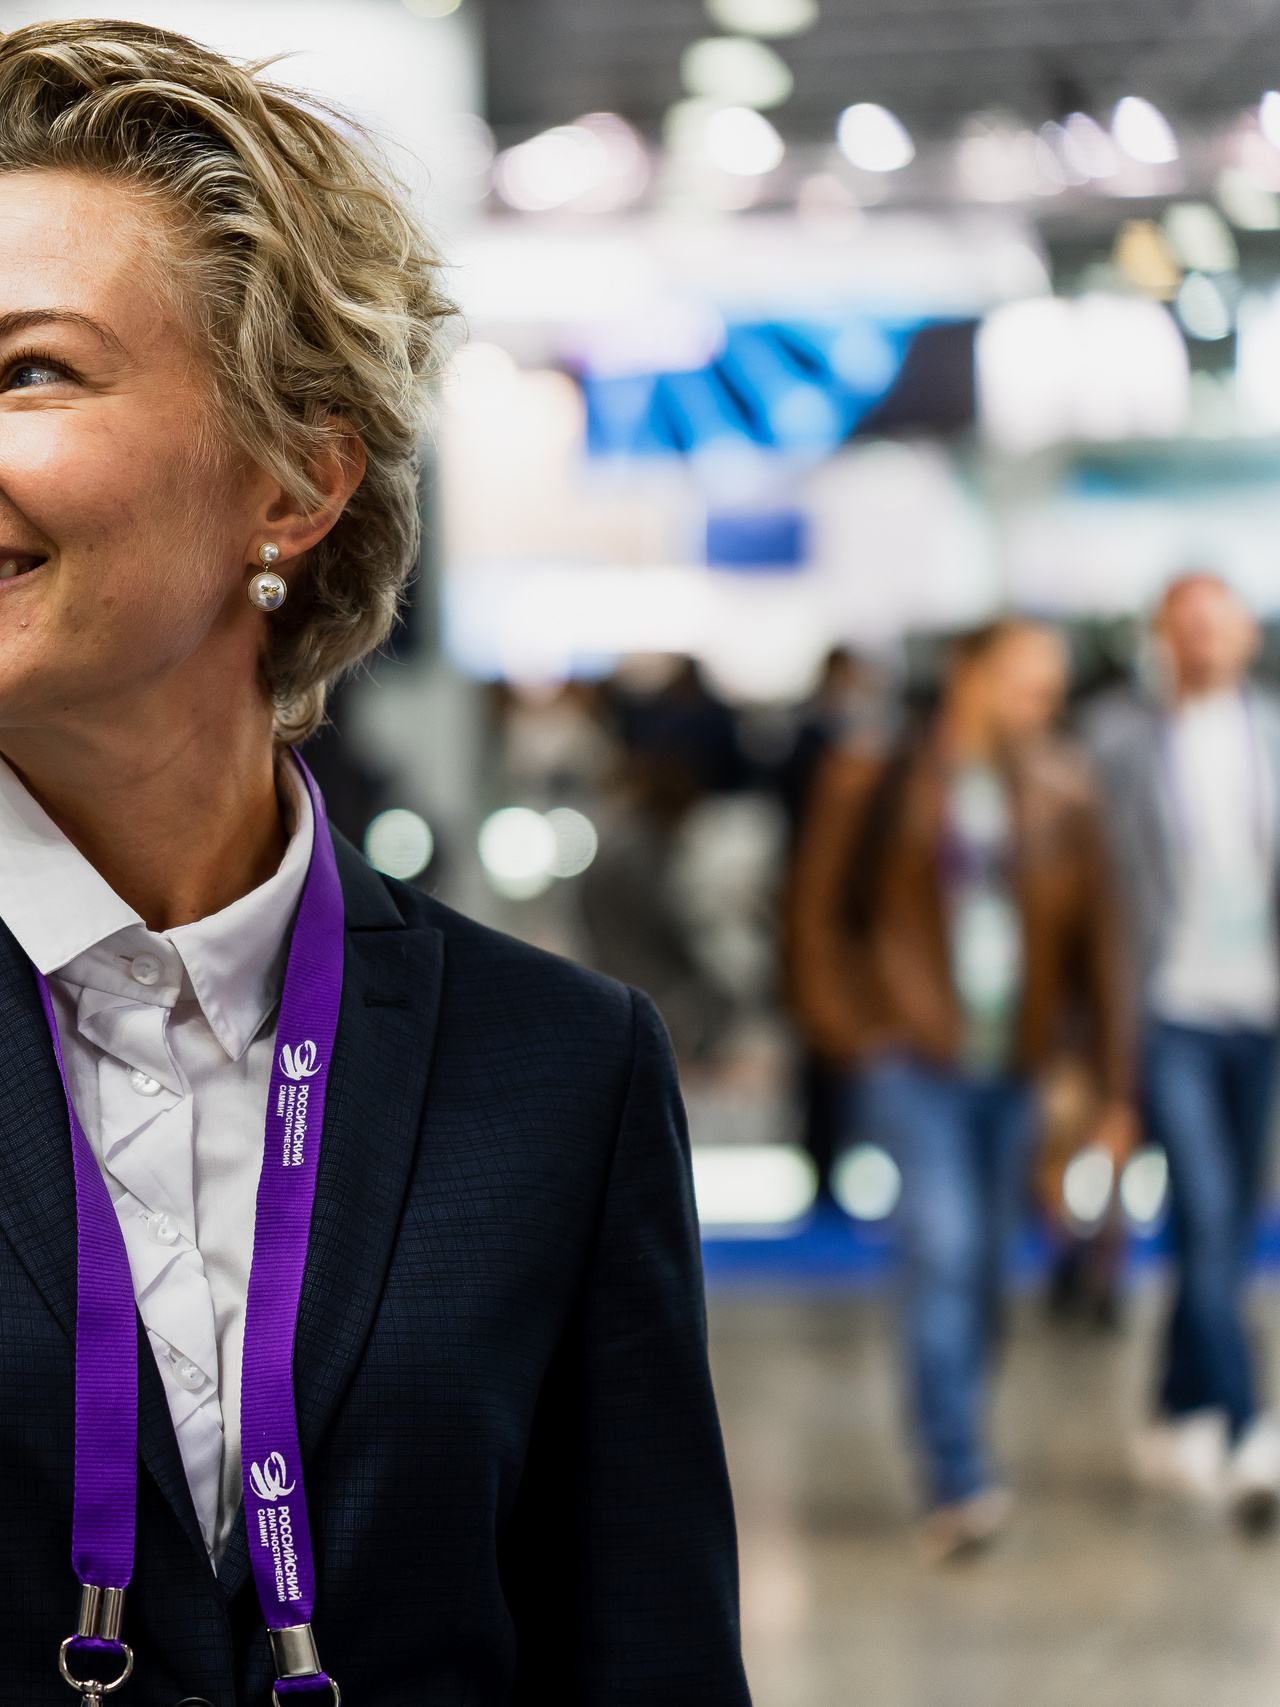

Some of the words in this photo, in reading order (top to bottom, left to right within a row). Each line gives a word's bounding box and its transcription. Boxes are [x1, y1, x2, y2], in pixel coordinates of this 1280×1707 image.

[276, 1084, 287, 1118] САММИТ
[282, 1085, 297, 1167] ДИАГНОСТИЧЕСКИЙ
[291, 1084, 310, 1167] РОССИЙСКИЙ
[257, 1509, 269, 1548] САММИТ
[266, 1508, 287, 1603] ДИАГНОСТИЧЕСКИЙ
[277, 1505, 302, 1601] РОССИЙСКИЙ
